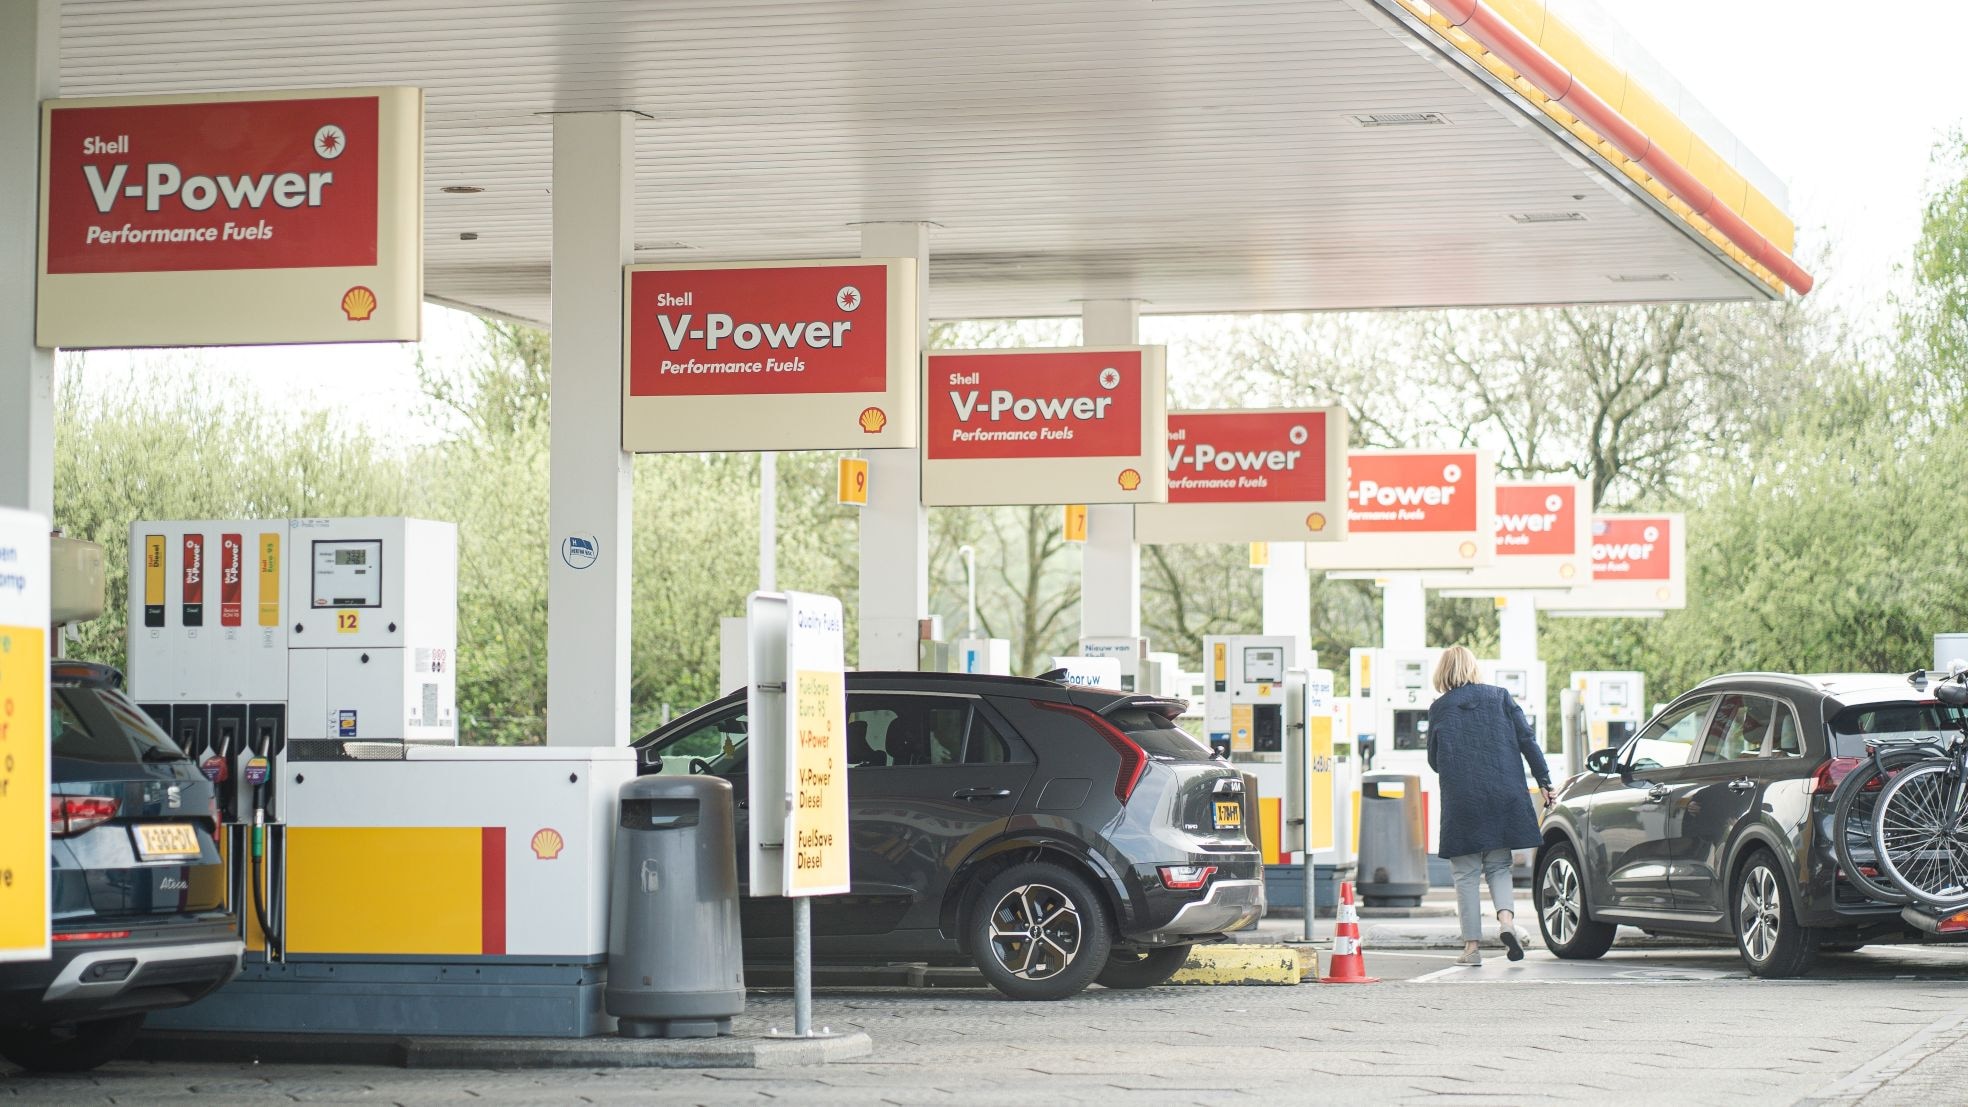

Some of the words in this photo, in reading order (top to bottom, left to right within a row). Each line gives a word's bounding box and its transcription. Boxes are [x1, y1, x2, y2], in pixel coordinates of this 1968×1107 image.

[83, 135, 129, 155] Shell
[82, 162, 333, 213] V-Power
[86, 223, 219, 244] Performance
[222, 220, 274, 241] Fuels
[656, 292, 693, 307] Shell
[656, 313, 851, 351] V-Power
[660, 358, 763, 375] Performance
[765, 356, 806, 373] Fuels
[949, 372, 980, 385] Shell
[949, 390, 1112, 422] V-Power
[952, 427, 1038, 442] Performance
[1040, 426, 1074, 440] Fuels
[1168, 429, 1186, 441] hell
[1168, 444, 1301, 472] V-Power
[856, 471, 865, 492] 9
[1168, 477, 1236, 489] erformance
[1238, 475, 1268, 488] Fuels
[1347, 480, 1456, 506] -Power
[1076, 513, 1085, 532] 7
[1397, 508, 1426, 521] Fuels
[1493, 513, 1558, 533] ower
[1592, 543, 1655, 561] ower
[192, 543, 200, 584] V-Power
[231, 543, 239, 584] V-Power
[338, 614, 358, 629] 12
[1408, 691, 1416, 703] 5
[799, 730, 830, 749] V-Power
[799, 768, 831, 787] V-Power
[799, 787, 823, 809] Diesel
[798, 829, 833, 849] FuelSave
[797, 850, 823, 870] Diesel
[160, 877, 189, 890] Ateca
